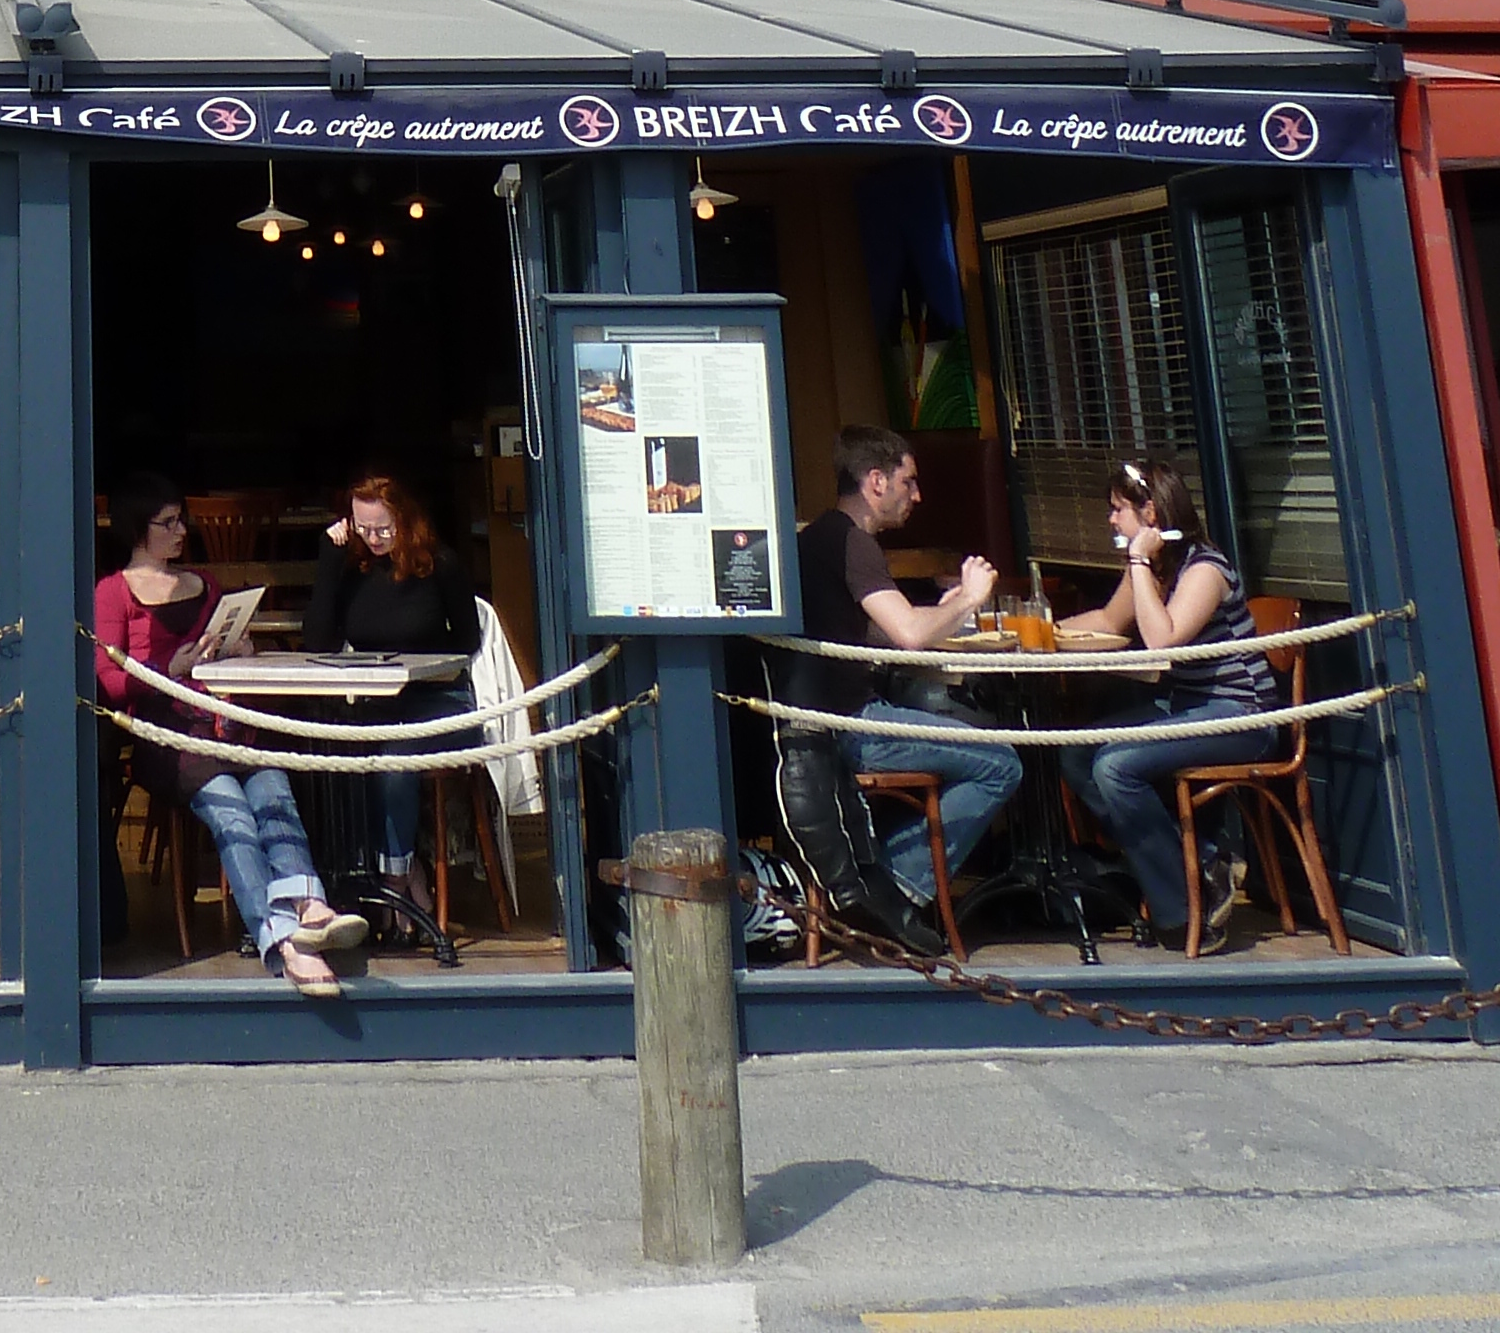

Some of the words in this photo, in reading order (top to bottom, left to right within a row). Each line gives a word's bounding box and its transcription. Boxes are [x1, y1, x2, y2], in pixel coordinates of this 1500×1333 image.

[78, 105, 181, 130] Café
[274, 110, 318, 135] La
[326, 113, 396, 148] crêpe
[404, 115, 544, 141] autrement
[633, 105, 788, 139] BREIZH
[800, 103, 902, 133] Café
[992, 108, 1033, 137] La
[1040, 113, 1108, 150] crêpe
[1115, 119, 1247, 148] autrement
